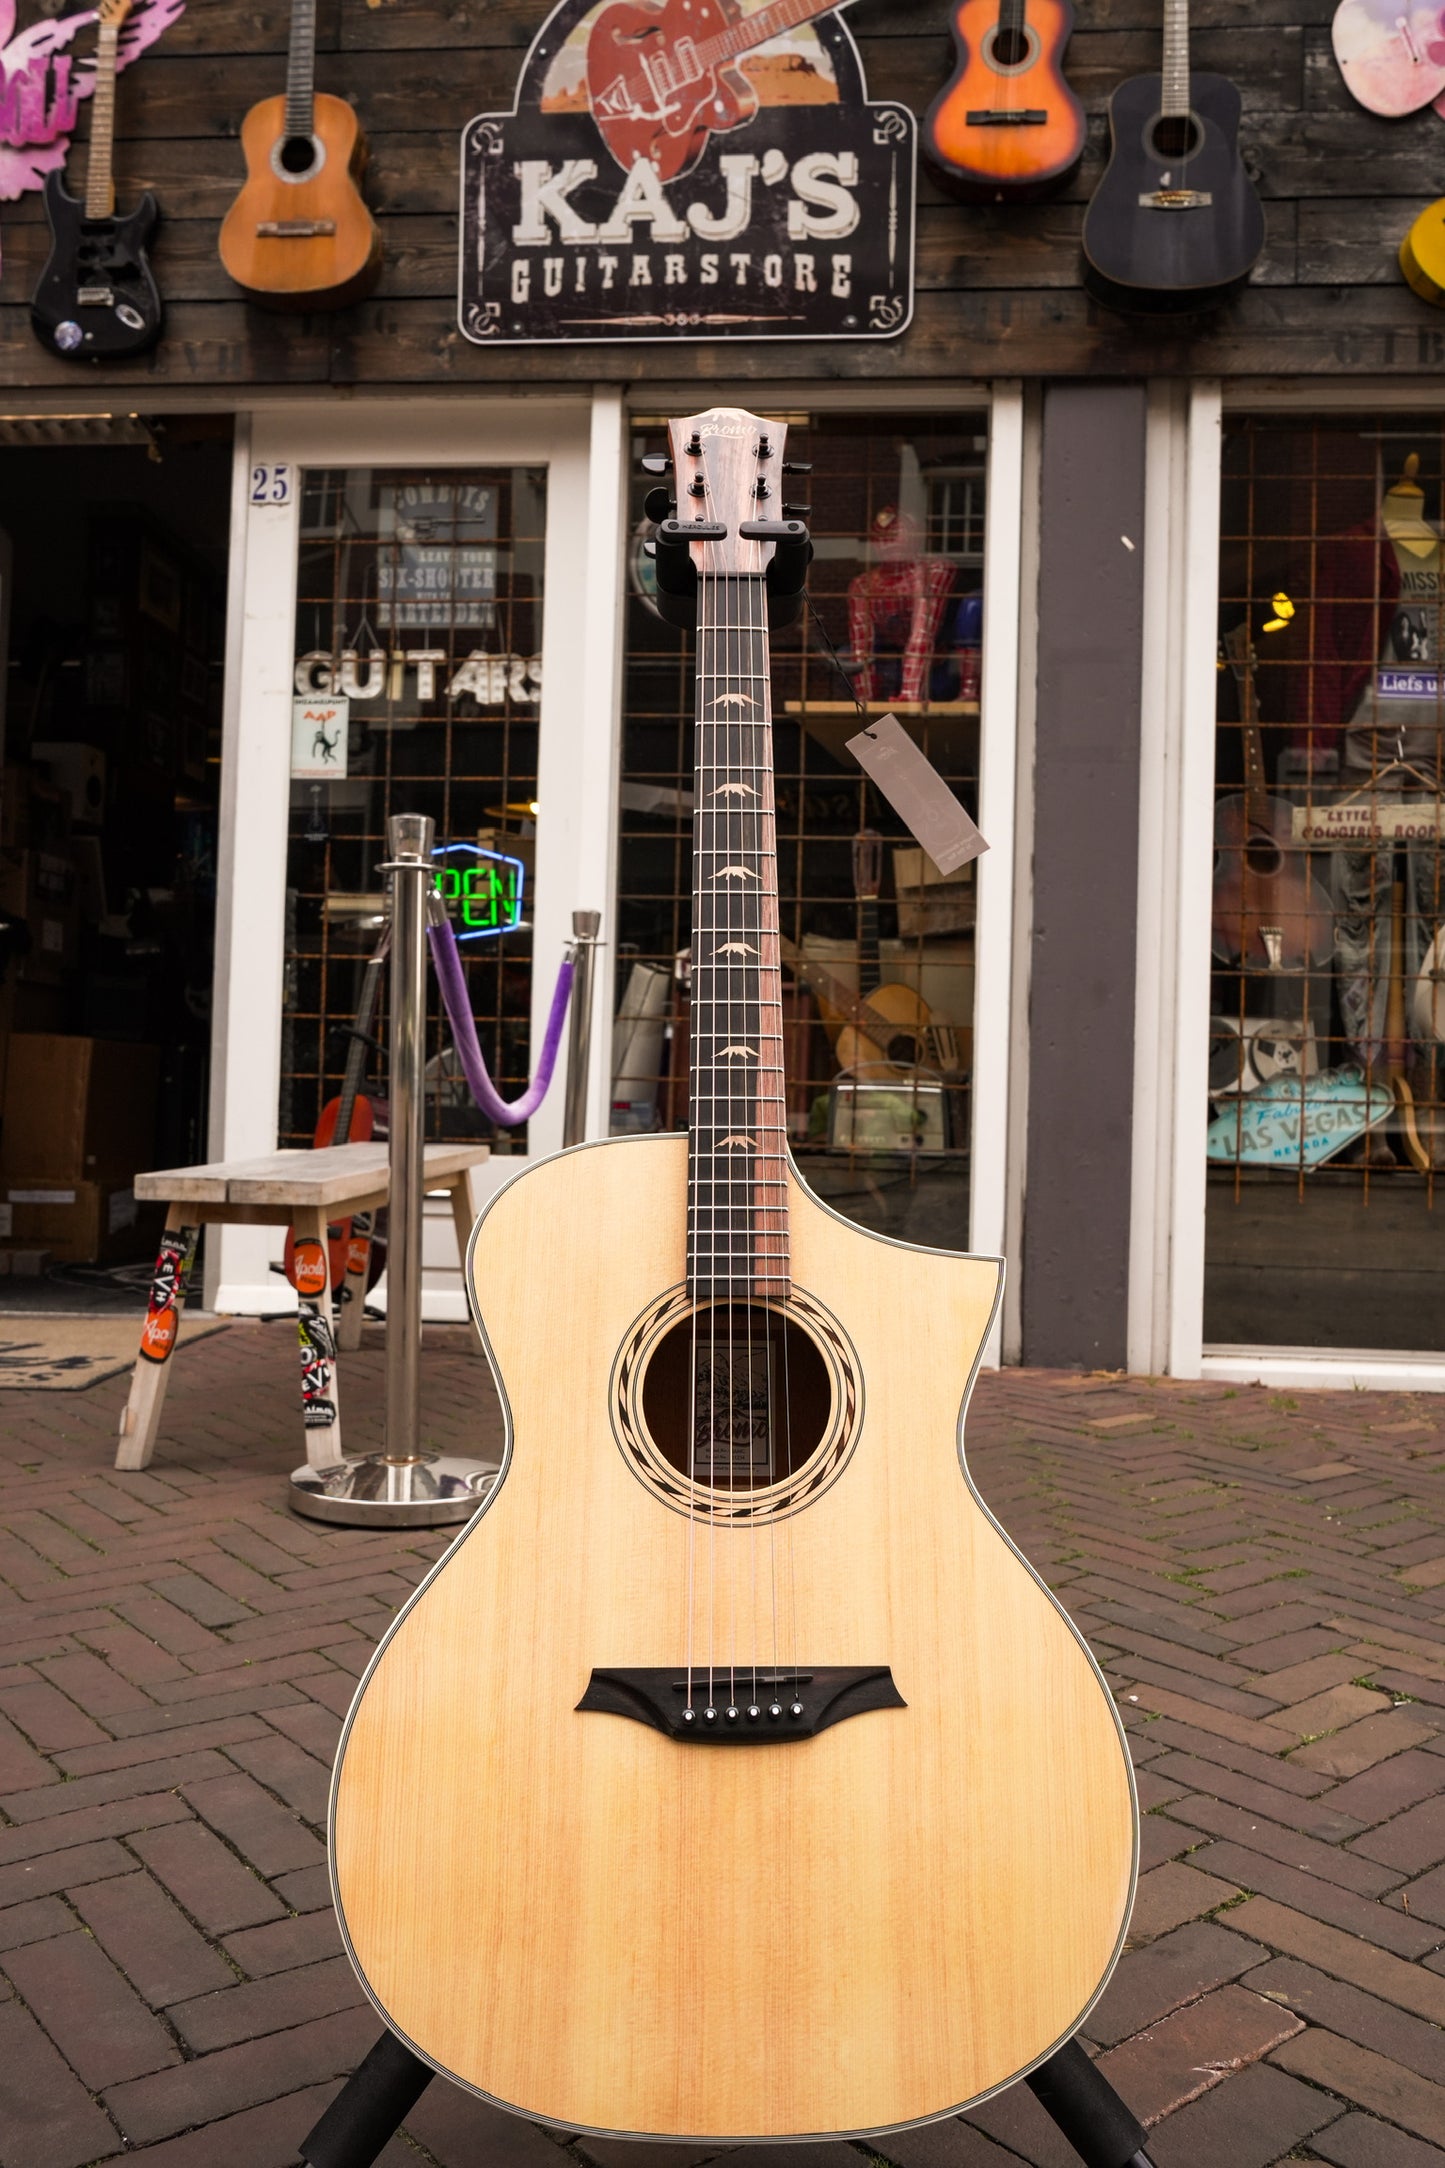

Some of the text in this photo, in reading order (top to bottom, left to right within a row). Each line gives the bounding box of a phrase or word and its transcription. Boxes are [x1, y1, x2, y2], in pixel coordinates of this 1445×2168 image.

[512, 149, 860, 246] KAJ'S
[511, 254, 852, 303] GUITARSTORE
[253, 467, 287, 500] 25
[378, 567, 494, 589] SIX-SHOOTER
[1382, 674, 1423, 691] Liefs
[303, 709, 337, 722] AAP
[1302, 825, 1382, 839] COWGIRLS
[435, 868, 516, 926] PEN
[1223, 1126, 1273, 1156] LAS
[1279, 1104, 1368, 1140] VEGAS
[1273, 1137, 1330, 1158] NEVADA
